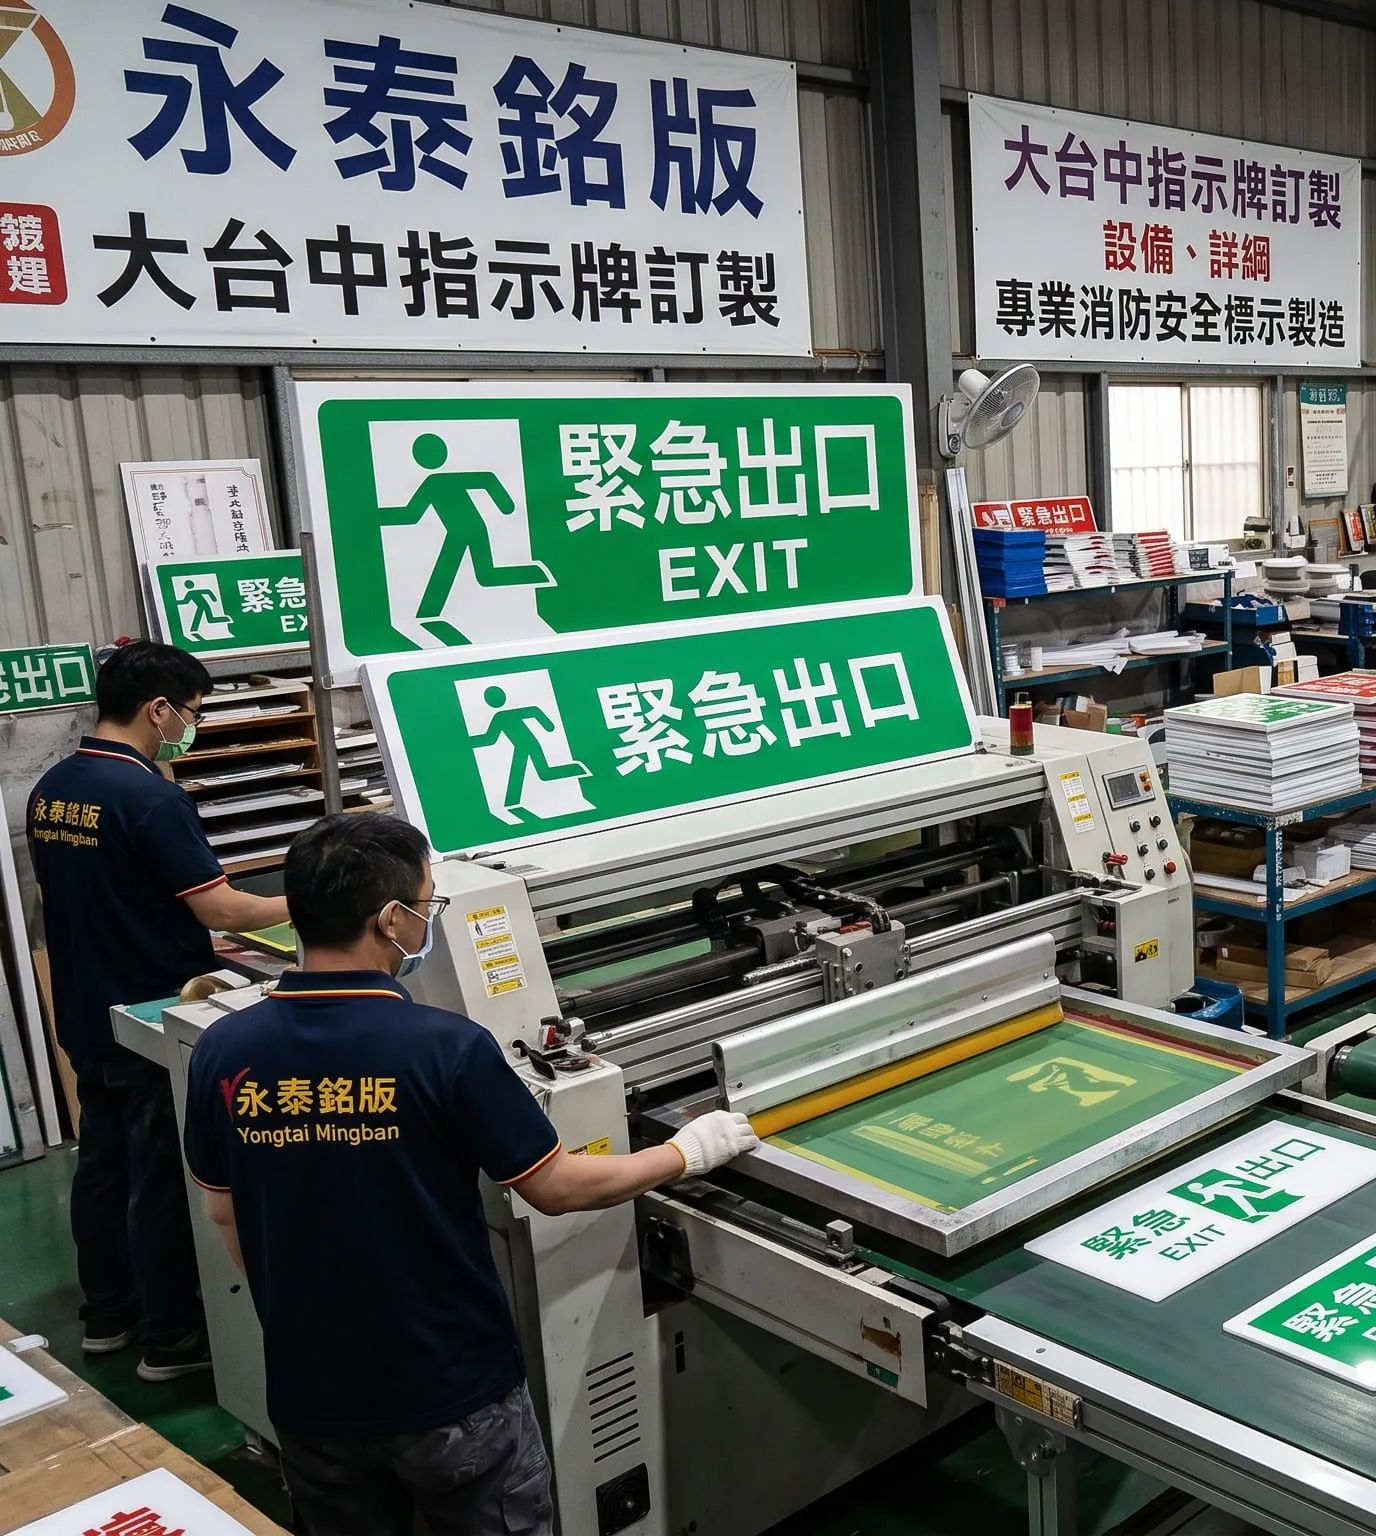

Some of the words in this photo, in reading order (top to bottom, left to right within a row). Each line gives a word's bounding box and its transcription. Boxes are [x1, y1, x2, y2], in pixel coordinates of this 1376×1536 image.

[123, 3, 764, 220] 永泰銘版
[1003, 124, 1342, 230] 大台中指示牌訂製
[92, 211, 782, 328] 大台中指示牌訂製
[995, 277, 1346, 349] 專業消防安全標示製造
[558, 417, 881, 533] 緊急出口
[658, 538, 809, 602] EXIT
[597, 651, 921, 776] 緊急出口
[236, 1077, 398, 1118] 永泰銘版
[236, 1124, 310, 1148] Yongtai
[316, 1123, 400, 1146] Mingban
[1080, 1208, 1192, 1260] 緊急
[1235, 1138, 1326, 1180] 出口
[1158, 1223, 1227, 1261] EXIT
